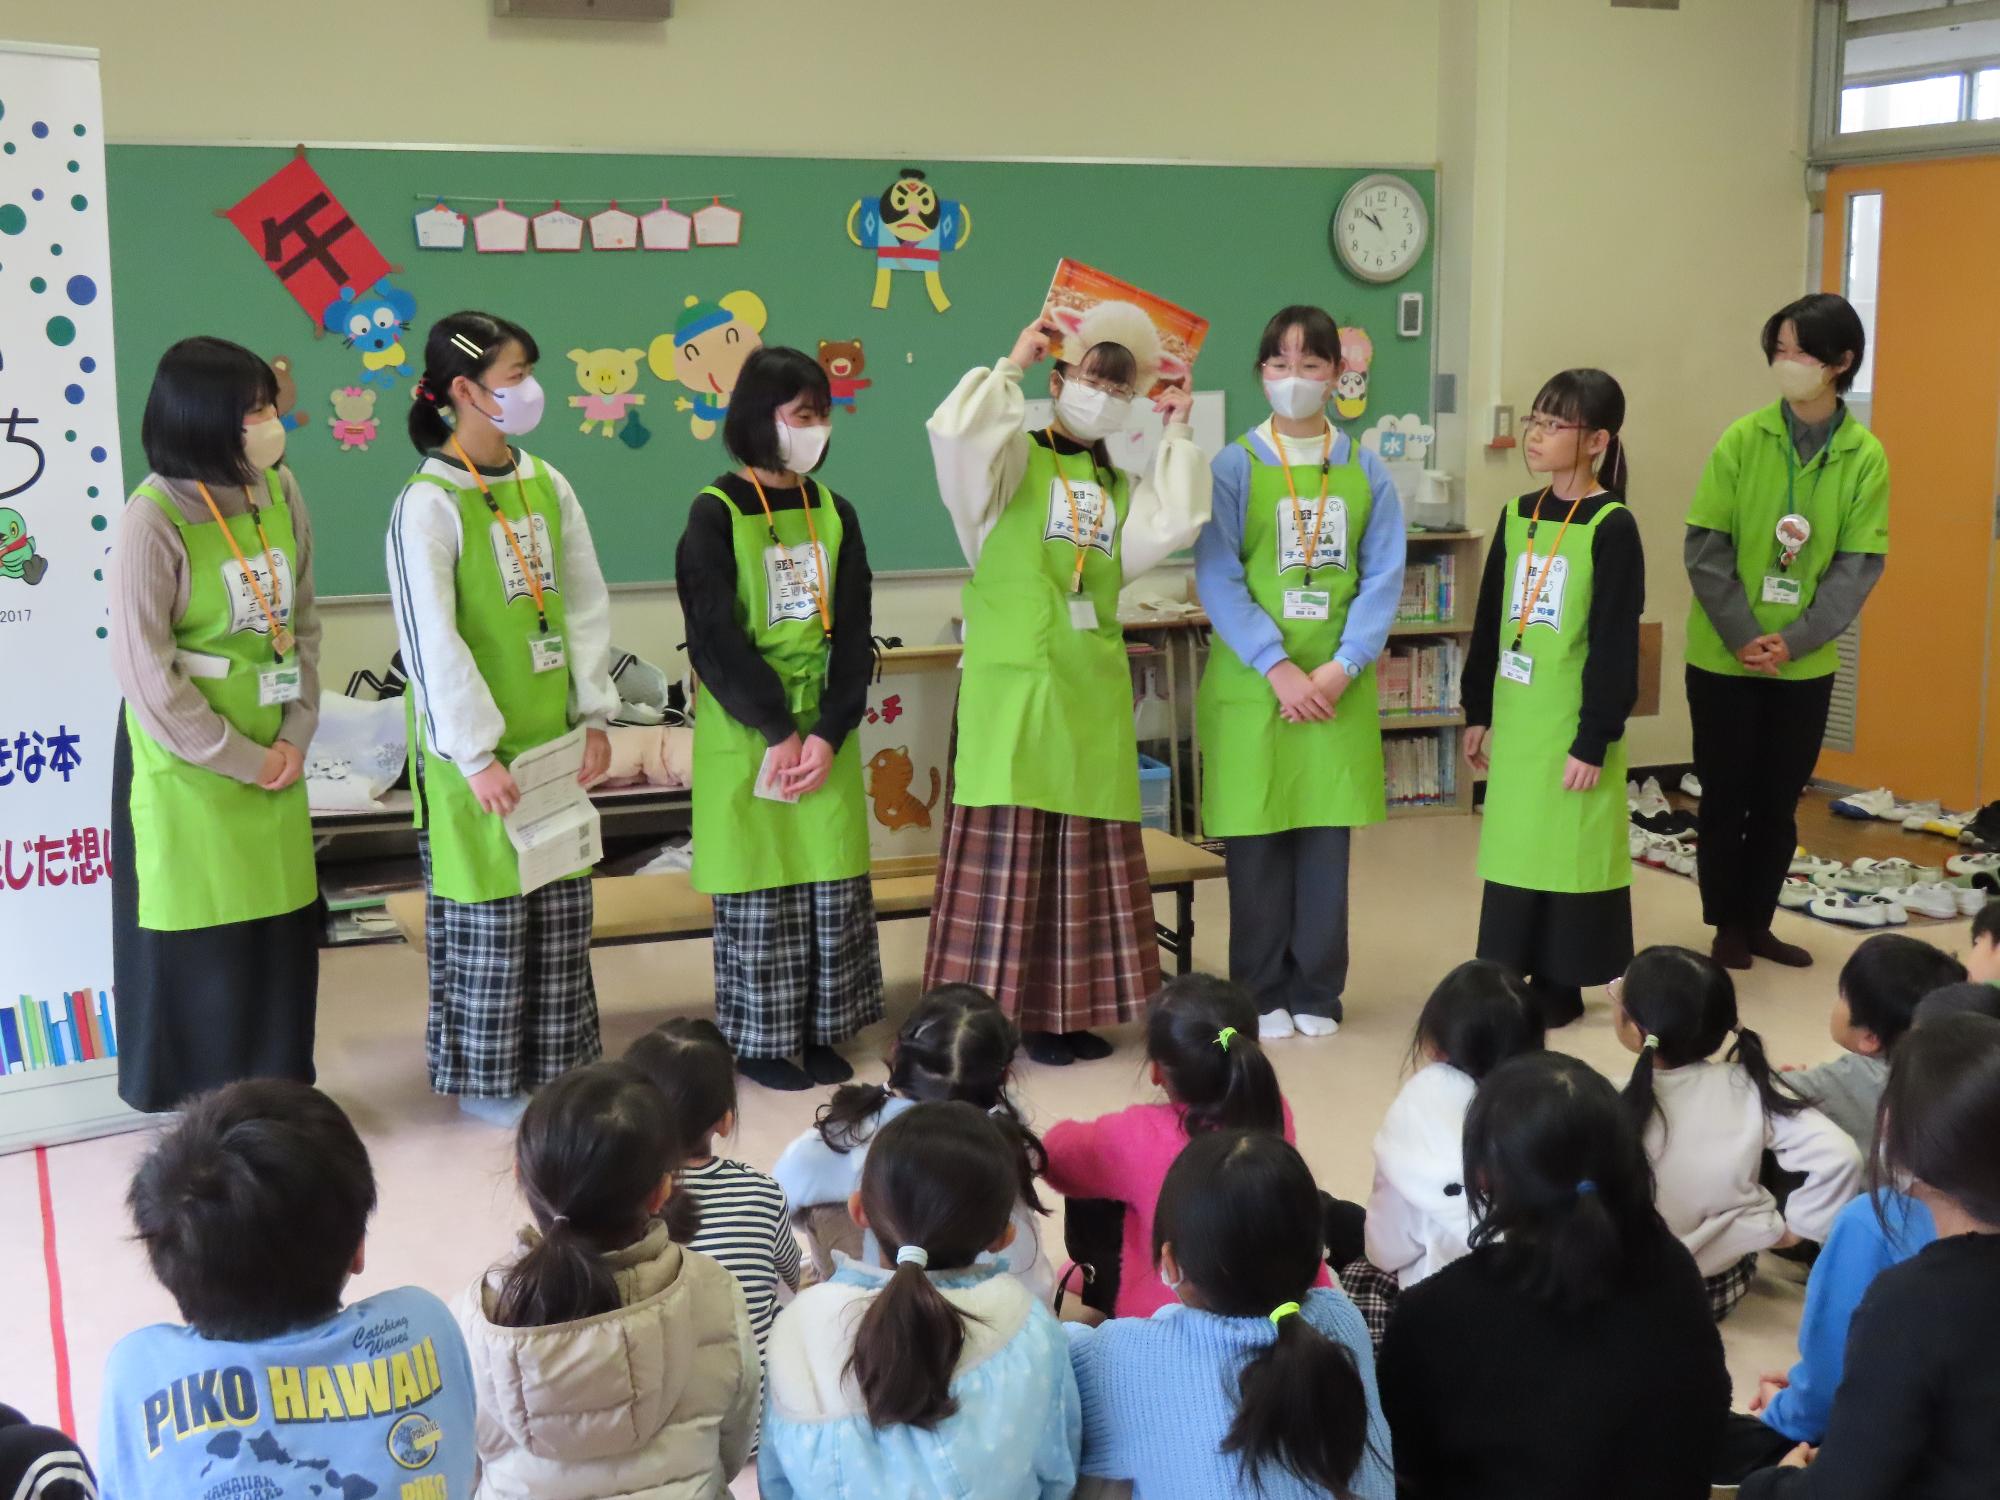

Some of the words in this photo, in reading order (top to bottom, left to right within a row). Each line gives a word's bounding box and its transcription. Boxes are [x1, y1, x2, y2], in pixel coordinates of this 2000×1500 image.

[1364, 195, 1373, 208] 11
[1377, 191, 1387, 202] 12
[1394, 195, 1398, 208] 1
[1354, 208, 1363, 218] 10
[1402, 207, 1409, 218] 2
[1348, 223, 1355, 234] 9
[1407, 223, 1413, 234] 3
[261, 191, 356, 286] 午
[1352, 240, 1358, 251] 8
[1401, 239, 1407, 251] 4
[1363, 250, 1369, 262] 7
[1376, 256, 1383, 266] 6
[1391, 250, 1398, 262] 5
[0, 610, 31, 623] 2017
[0, 827, 112, 891] じた想
[353, 1315, 408, 1350] Catching
[365, 1330, 408, 1357] Waves
[144, 1365, 260, 1459] PIKO
[267, 1336, 443, 1424] HAWAII
